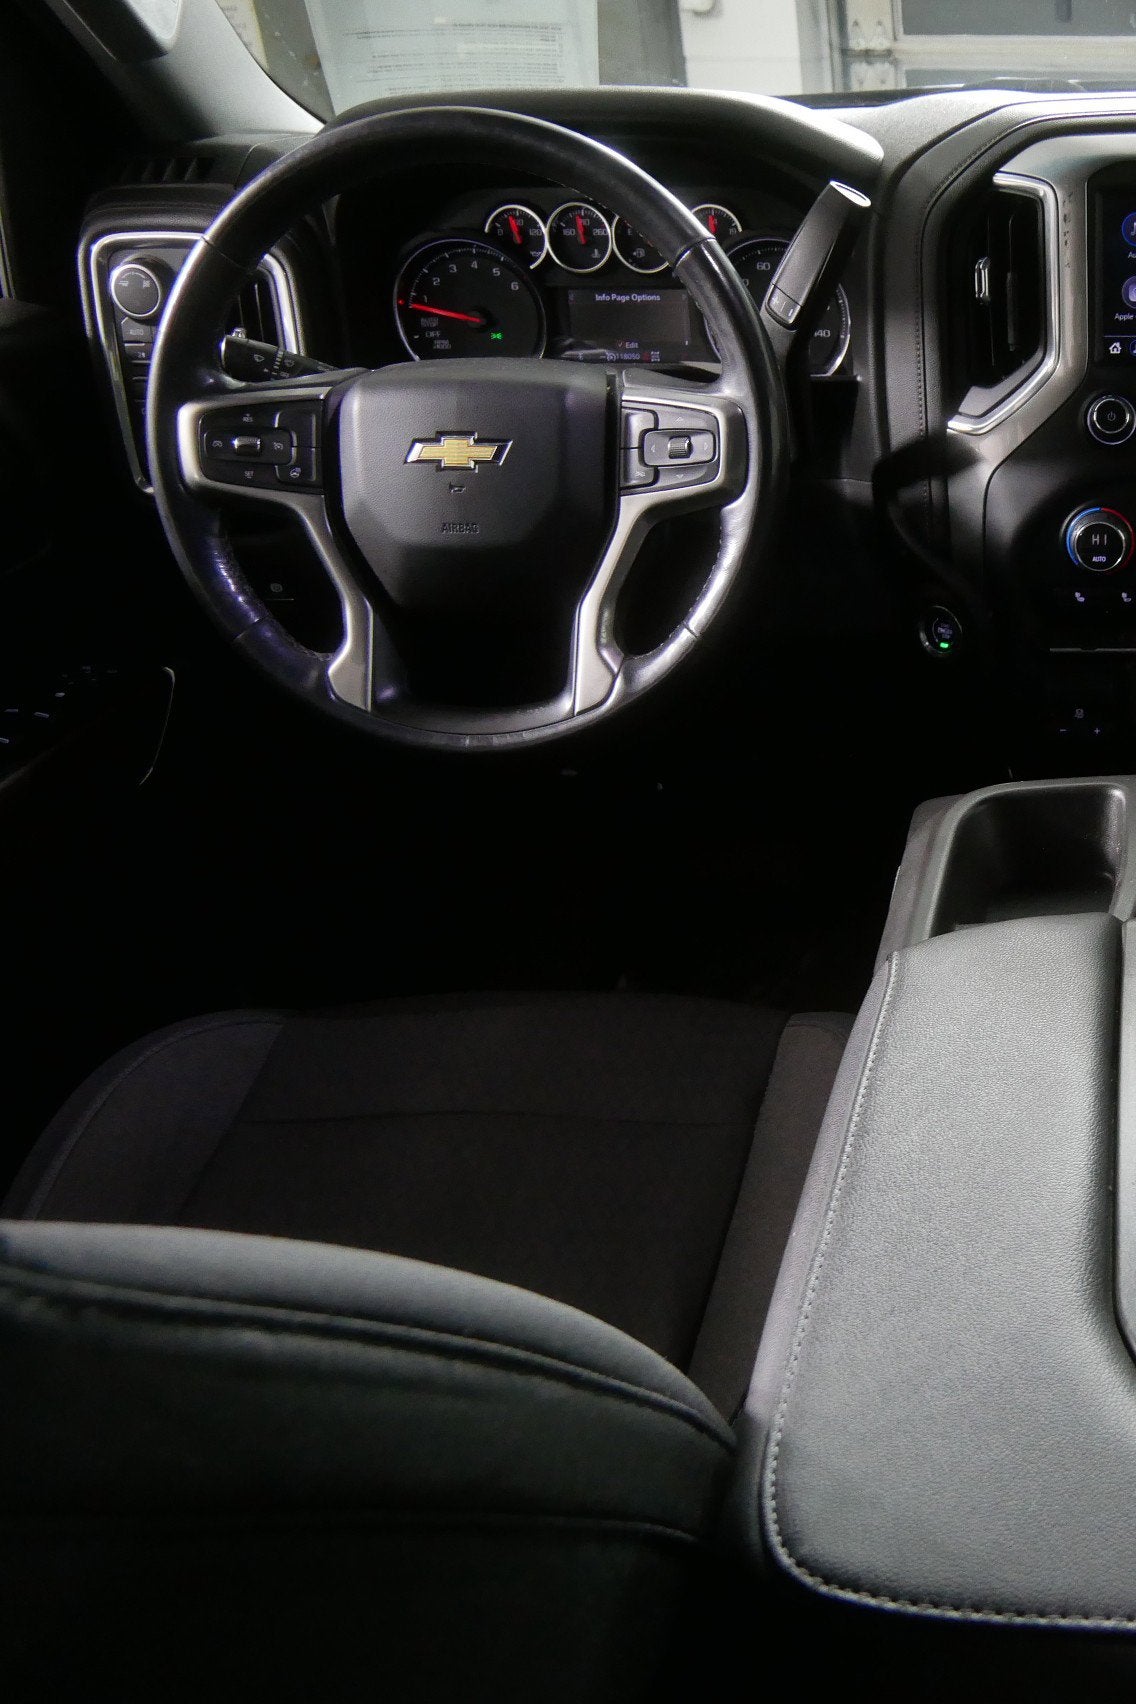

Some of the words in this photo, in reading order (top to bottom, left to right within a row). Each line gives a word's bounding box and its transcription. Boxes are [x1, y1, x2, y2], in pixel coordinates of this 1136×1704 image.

[448, 263, 457, 273] 3
[470, 260, 478, 270] 4
[756, 262, 770, 271] 60
[492, 267, 501, 277] 5
[431, 277, 440, 286] 2
[510, 281, 519, 291] 6
[595, 293, 610, 301] Info
[611, 293, 630, 304] Page
[631, 293, 661, 302] Options
[1114, 312, 1133, 321] Apple
[625, 341, 639, 349] Edit
[441, 522, 479, 534] AIRBAG
[1092, 555, 1107, 563] AUTO
